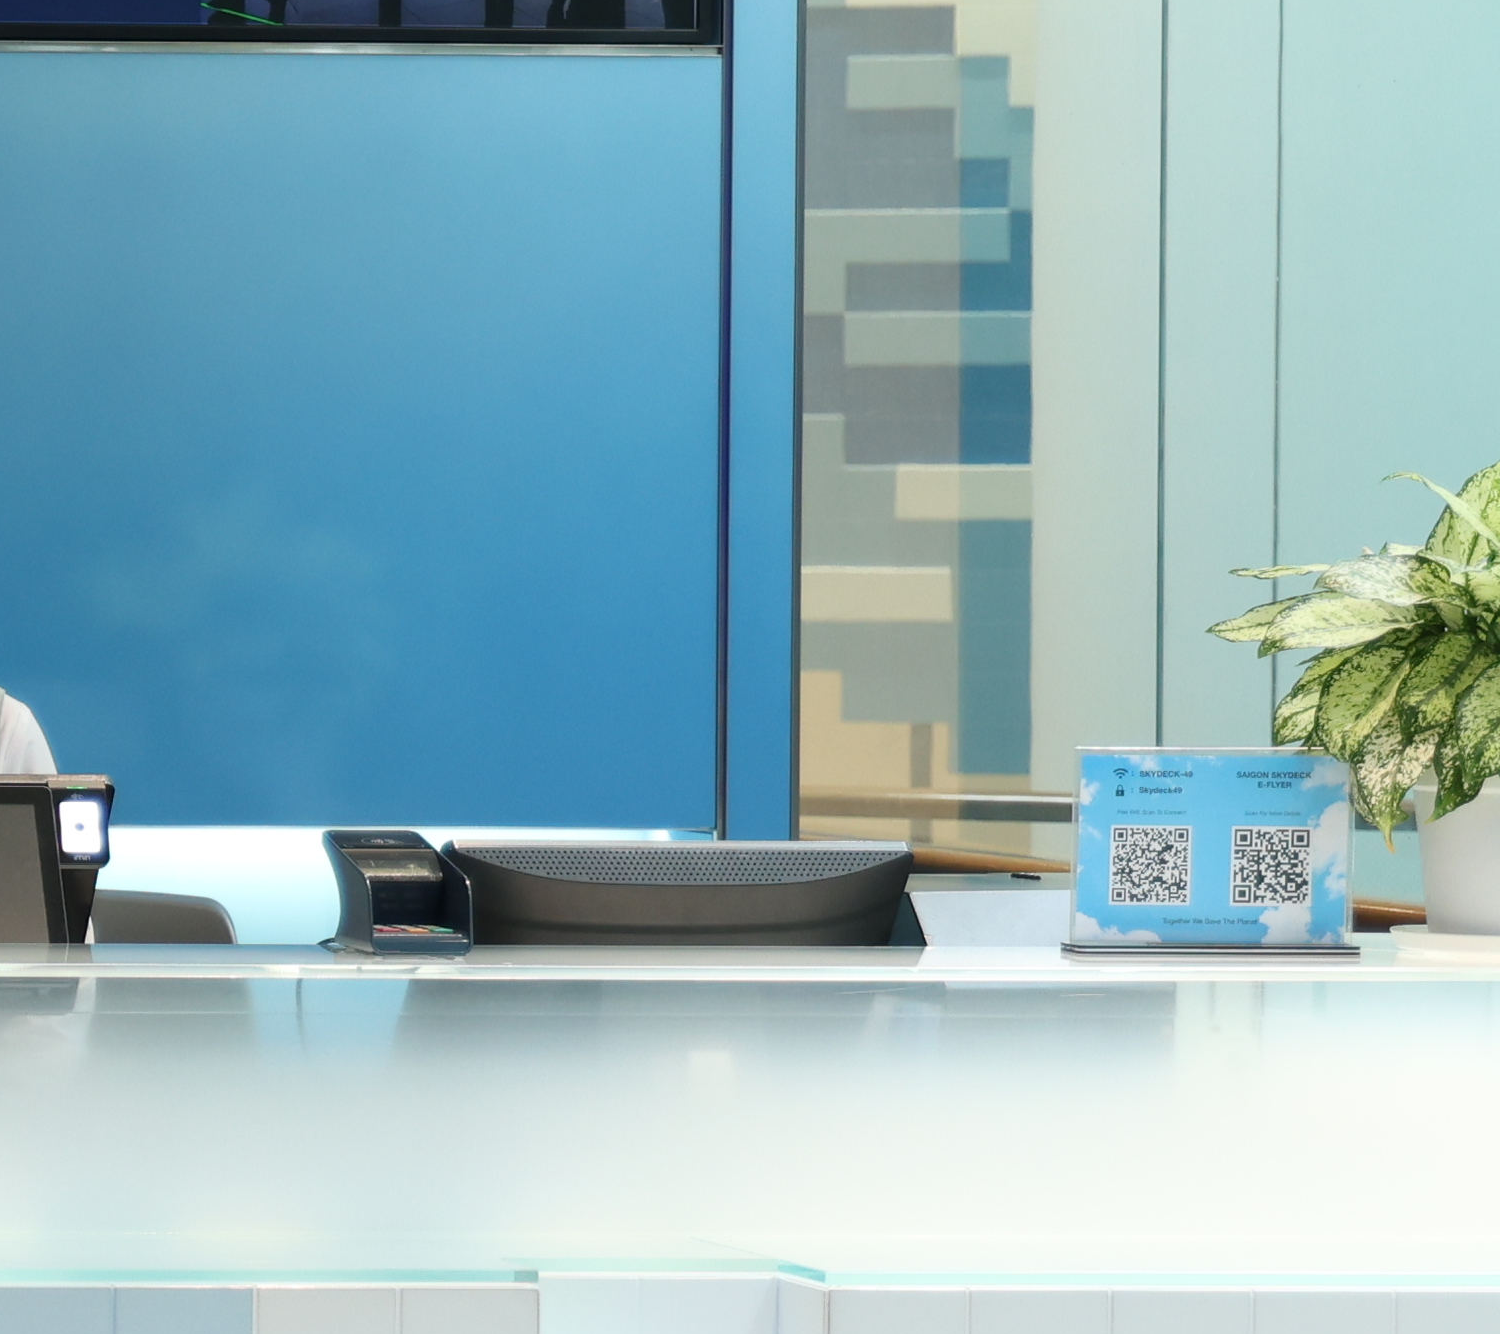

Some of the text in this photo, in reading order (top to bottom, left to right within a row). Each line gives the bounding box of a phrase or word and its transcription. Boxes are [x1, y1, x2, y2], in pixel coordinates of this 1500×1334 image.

[1236, 771, 1311, 779] SAIGON SKYDECK
[1257, 781, 1292, 789] E-FLYER
